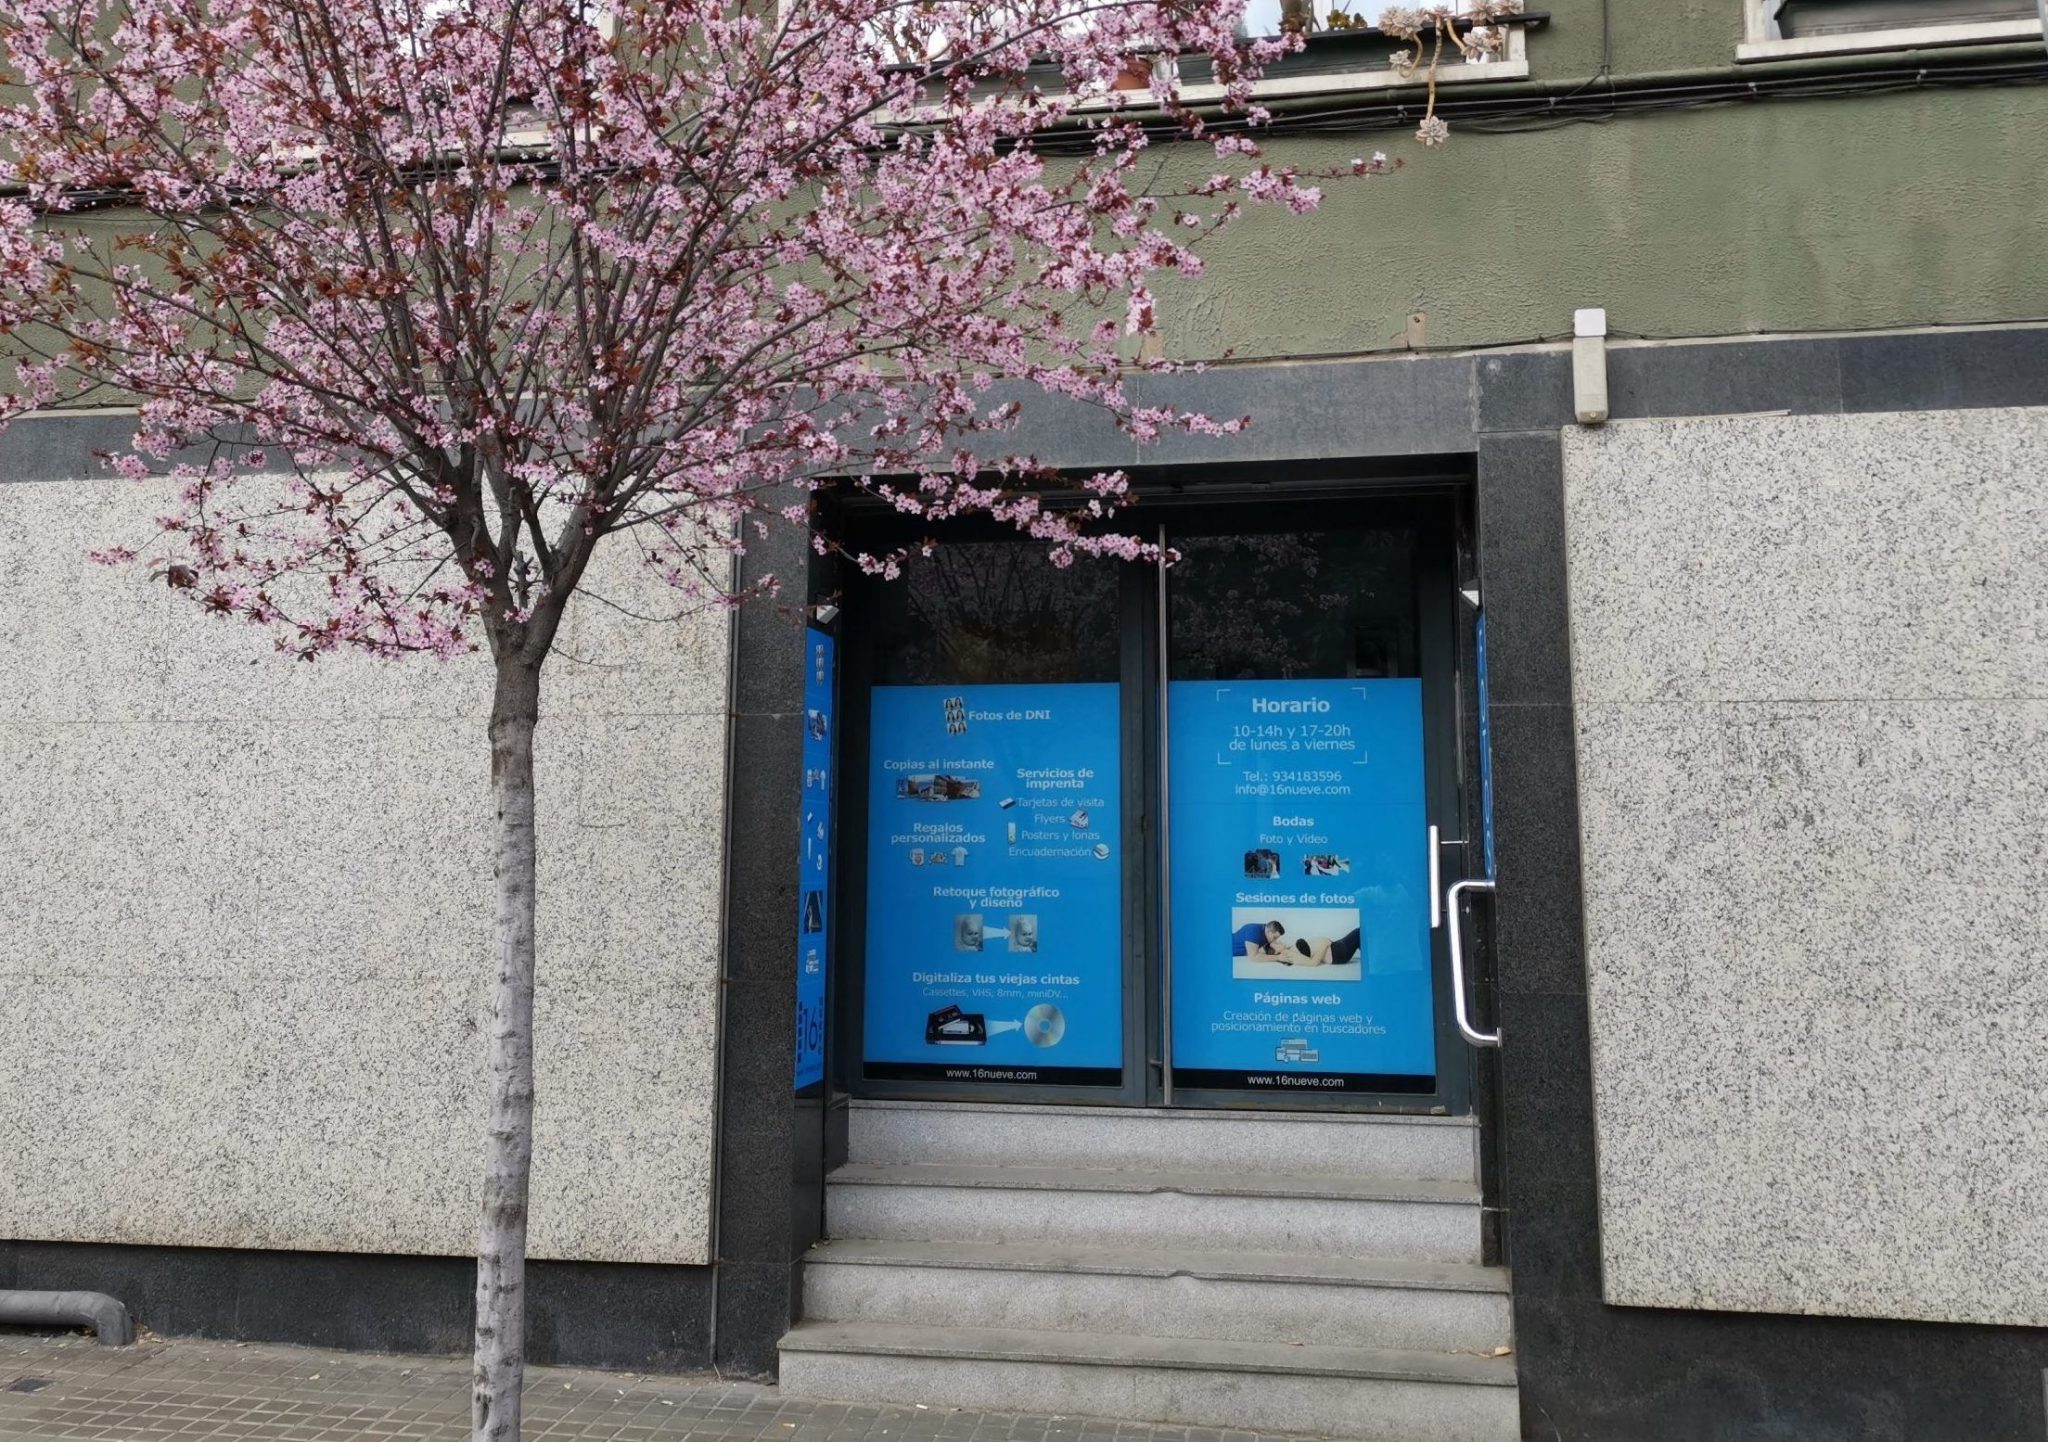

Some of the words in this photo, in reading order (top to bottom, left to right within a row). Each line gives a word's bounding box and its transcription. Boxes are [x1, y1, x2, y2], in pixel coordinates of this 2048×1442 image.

[1252, 697, 1331, 713] Horario
[968, 710, 1003, 720] Fotos
[1006, 710, 1022, 720] de
[1025, 710, 1051, 720] DNI
[1233, 725, 1283, 737] 10-14h
[1288, 727, 1296, 739] y
[1301, 724, 1351, 737] 17-20h
[1229, 739, 1246, 750] de
[1251, 739, 1287, 750] lunes
[1292, 741, 1299, 750] a
[1305, 738, 1356, 750] viernes
[883, 759, 925, 770] Copias
[928, 759, 940, 769] al
[943, 759, 994, 769] instante
[1017, 768, 1076, 778] Servicios
[1080, 768, 1094, 778] de
[1242, 772, 1268, 781] Tel.:
[1273, 771, 1342, 781] 934183596
[1026, 778, 1084, 790] imprenta
[1235, 784, 1351, 795] info@16nueve.com
[1017, 798, 1057, 809] Tarjetas
[1061, 798, 1073, 807] de
[1077, 798, 1104, 807] visita
[1034, 814, 1066, 825] Flyers
[1273, 816, 1314, 826] Bodas
[913, 823, 963, 834] Regalos
[891, 833, 986, 844] personalizados
[1021, 831, 1059, 840] Posters
[1062, 833, 1069, 842] y
[1071, 831, 1100, 840] lonas
[1259, 834, 1283, 844] Foto
[1287, 836, 1294, 845] y
[1009, 846, 1092, 857] Encuadernación
[933, 887, 986, 898] Retoque
[989, 886, 1060, 899] fotográfico
[1236, 892, 1296, 903] Sesiones
[1299, 893, 1316, 903] de
[1320, 893, 1355, 904] fotos
[969, 900, 977, 909] y
[980, 898, 1023, 908] diseño
[912, 972, 972, 985] Digitaliza
[975, 973, 996, 984] tus
[999, 973, 1037, 986] viejas
[1040, 973, 1080, 985] cintas
[1254, 992, 1308, 1005] Páginas
[1311, 994, 1341, 1005] web
[1223, 1011, 1272, 1021] Creación
[1275, 1012, 1288, 1022] de
[1293, 1012, 1335, 1025] páginas
[1339, 1013, 1363, 1023] web
[1366, 1016, 1373, 1025] y
[1211, 1022, 1301, 1033] posicionamiento
[1304, 1025, 1319, 1033] en
[1322, 1024, 1386, 1034] buscadores
[946, 1068, 1037, 1080] www.16nueve.com
[1247, 1076, 1344, 1087] www.16nueve.com
